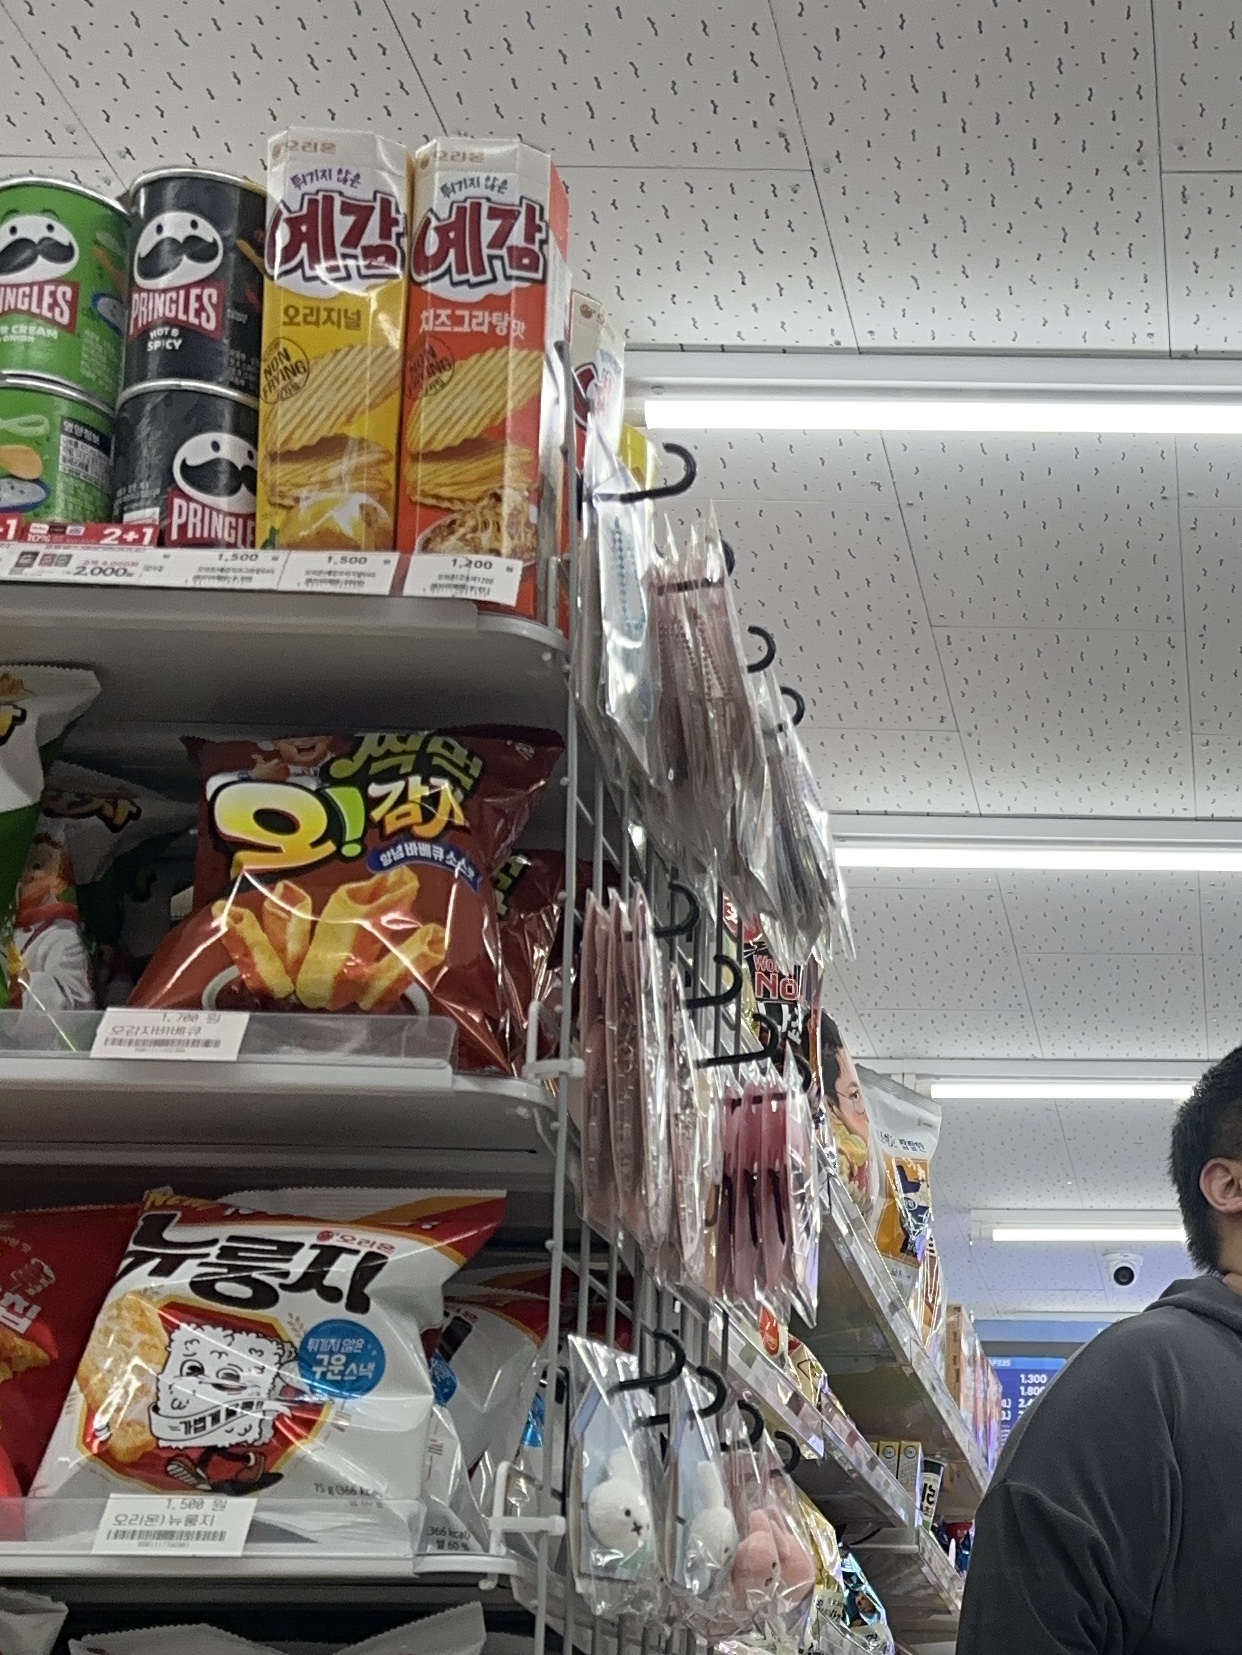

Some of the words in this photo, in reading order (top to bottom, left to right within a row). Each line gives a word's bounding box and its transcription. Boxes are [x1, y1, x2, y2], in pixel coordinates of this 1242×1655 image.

[290, 167, 334, 190] 튀기지
[336, 167, 362, 189] 않은
[440, 177, 481, 199] 튀기지
[483, 175, 510, 196] 않은
[266, 191, 405, 281] 예감
[411, 197, 548, 287] 예감
[130, 287, 217, 333] PRINGLES
[282, 304, 363, 331] 오리지널
[419, 309, 526, 340] 치즈그라탕맛
[147, 339, 182, 352] SPICY
[263, 347, 292, 378] NON
[262, 360, 308, 401] FRYING
[100, 527, 153, 545] 2+1
[218, 553, 259, 563] 1,500
[327, 555, 368, 565] 1,500
[333, 1230, 396, 1254] 오리온
[115, 1212, 389, 1315] 뉴룽지
[307, 1337, 341, 1353] 튀기지
[341, 1337, 365, 1354] 않은
[166, 1499, 205, 1511] 1,500
[212, 1499, 228, 1512] 원
